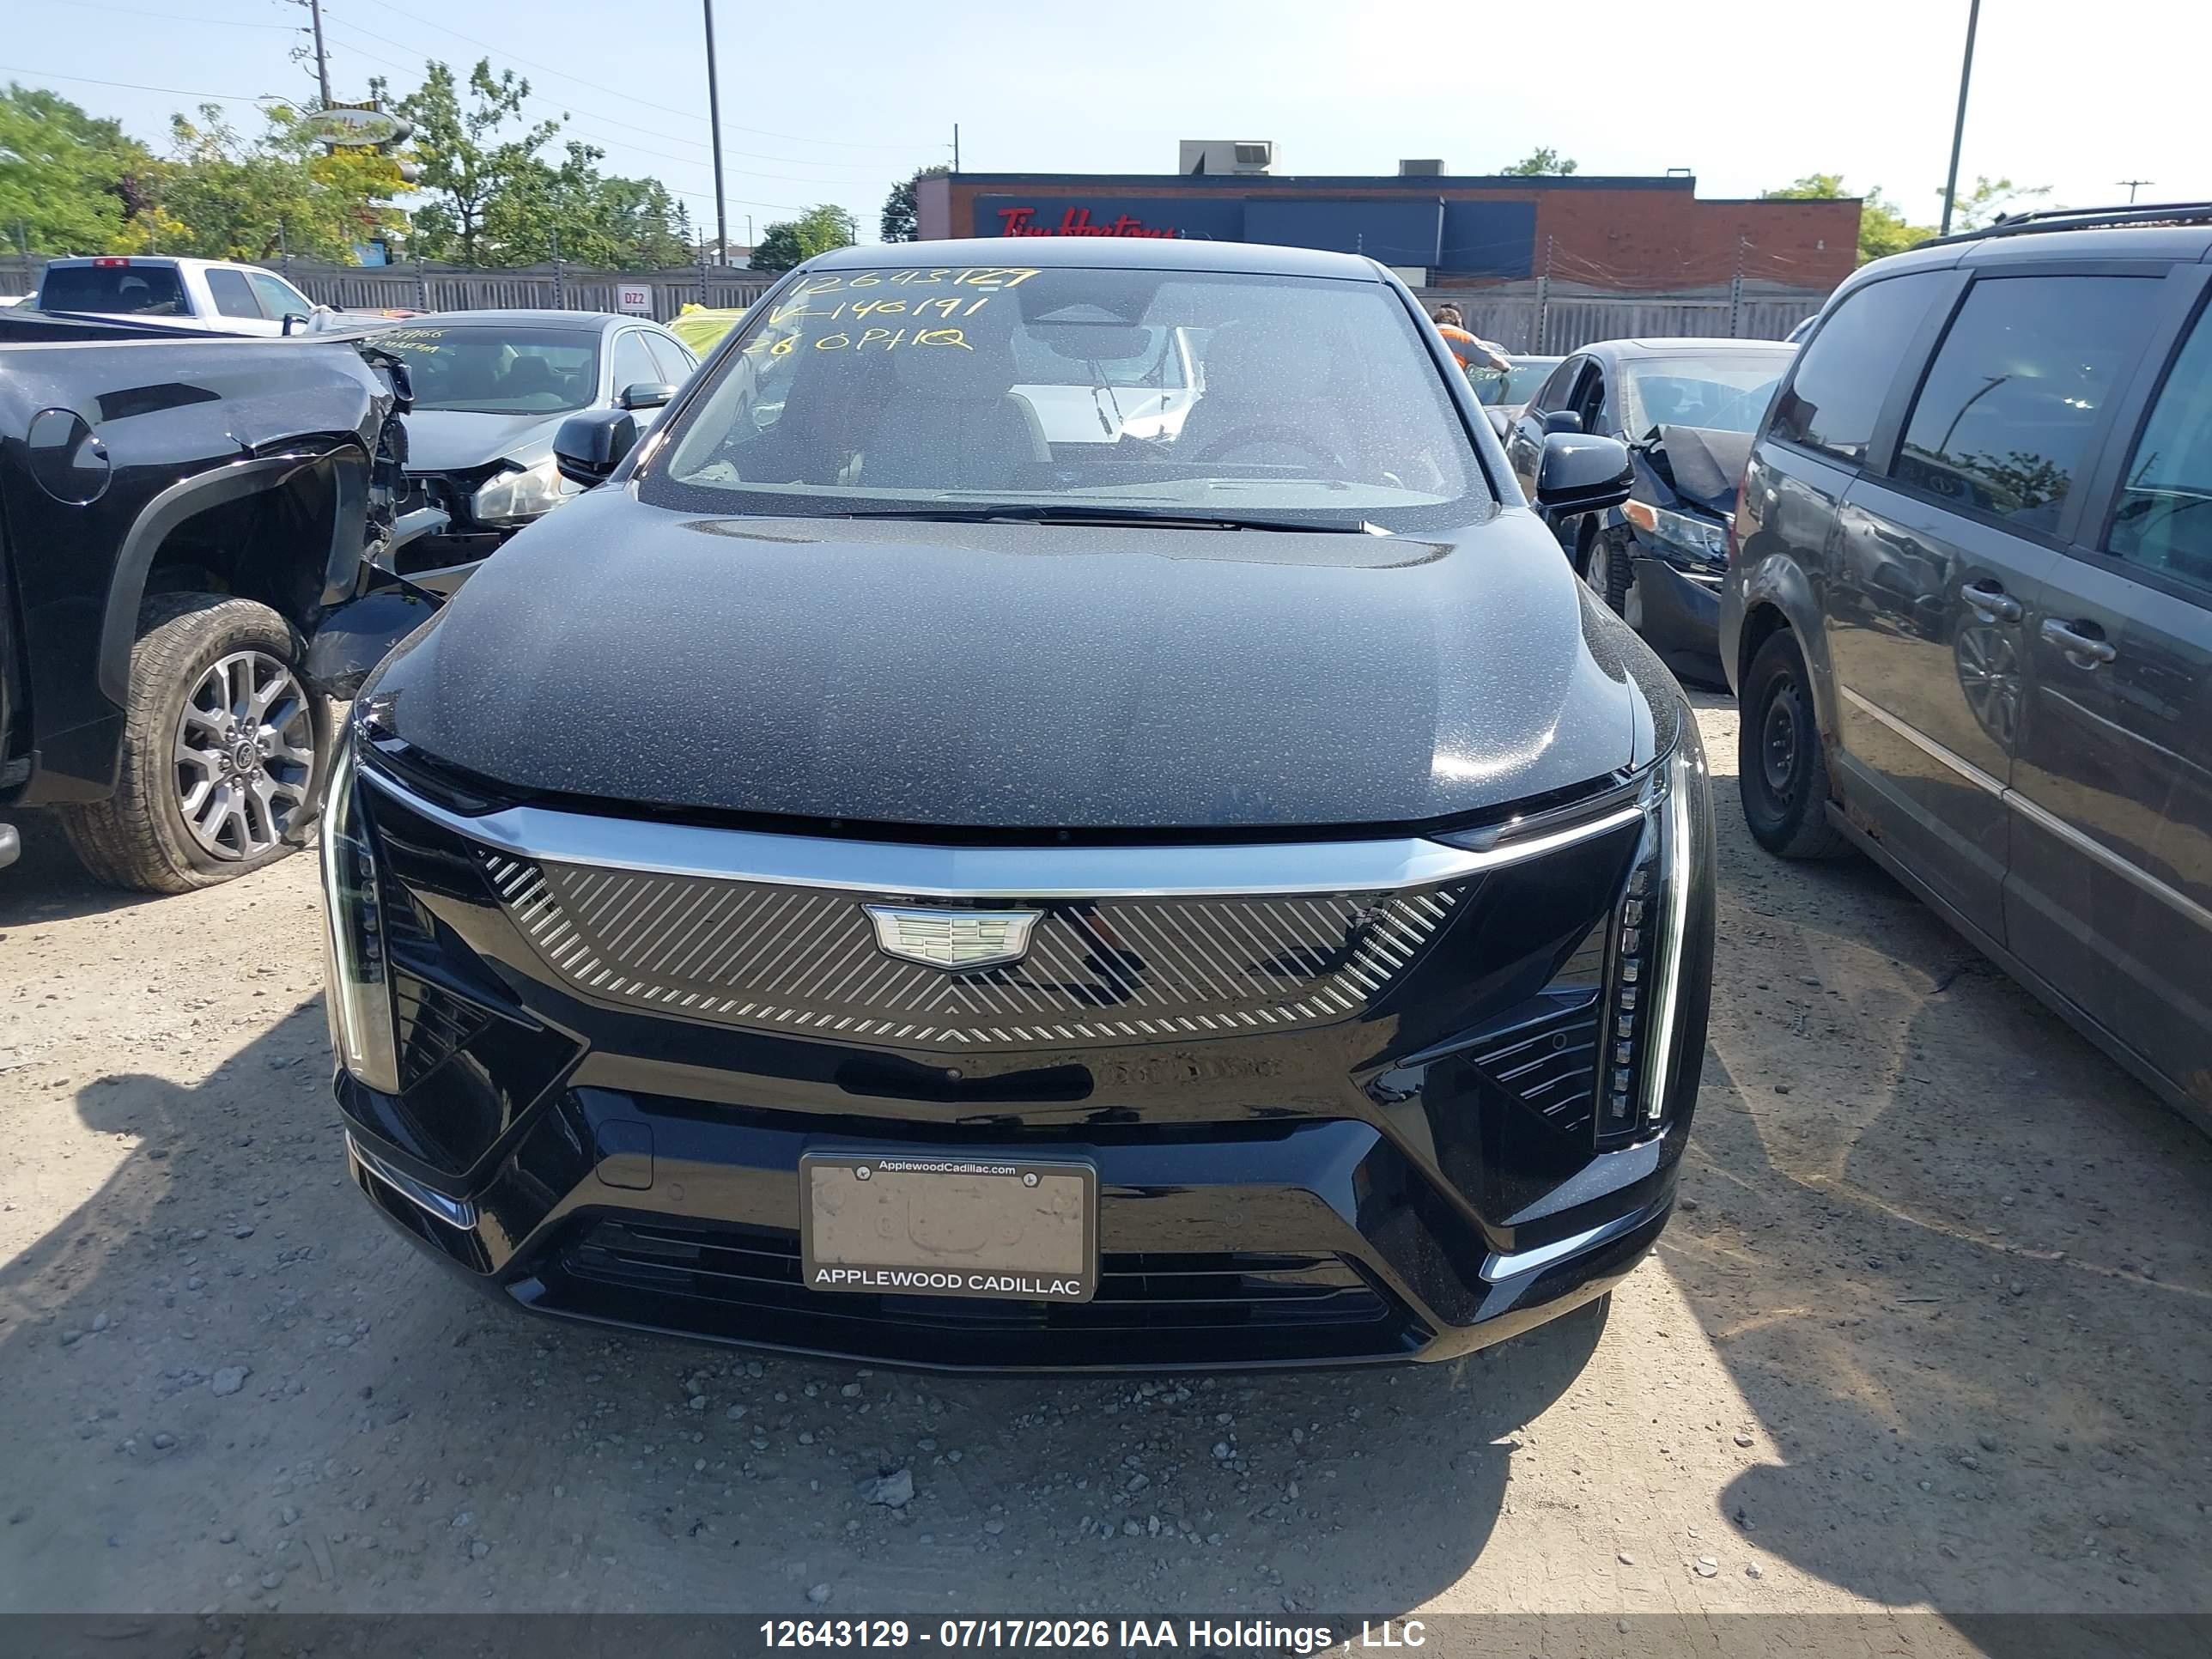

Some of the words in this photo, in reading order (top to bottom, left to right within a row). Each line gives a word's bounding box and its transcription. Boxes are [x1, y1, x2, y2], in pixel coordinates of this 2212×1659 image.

[789, 269, 1043, 296] 12643129
[624, 292, 645, 305] DZ2
[878, 1160, 1017, 1176] ApplewoodCadillac.com
[815, 1268, 963, 1289] APPLEWOOD
[968, 1274, 1081, 1296] CADILLAC
